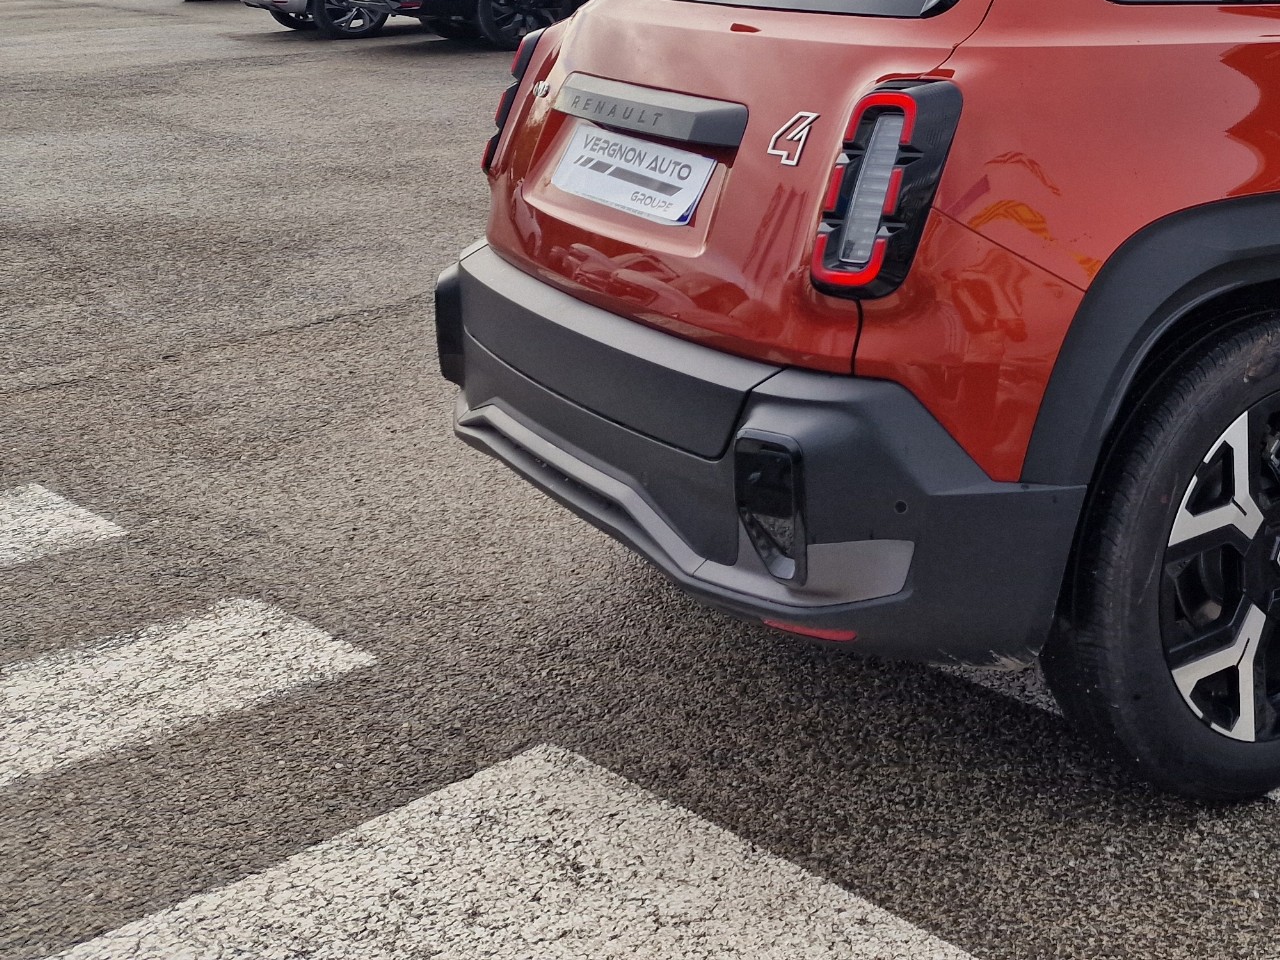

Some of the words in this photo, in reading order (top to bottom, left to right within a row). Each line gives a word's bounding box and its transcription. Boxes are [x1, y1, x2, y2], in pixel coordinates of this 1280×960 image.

[571, 95, 666, 127] RENAULT
[583, 133, 648, 167] VERGNON
[647, 155, 692, 181] AUTO
[630, 191, 674, 213] GROUPE
